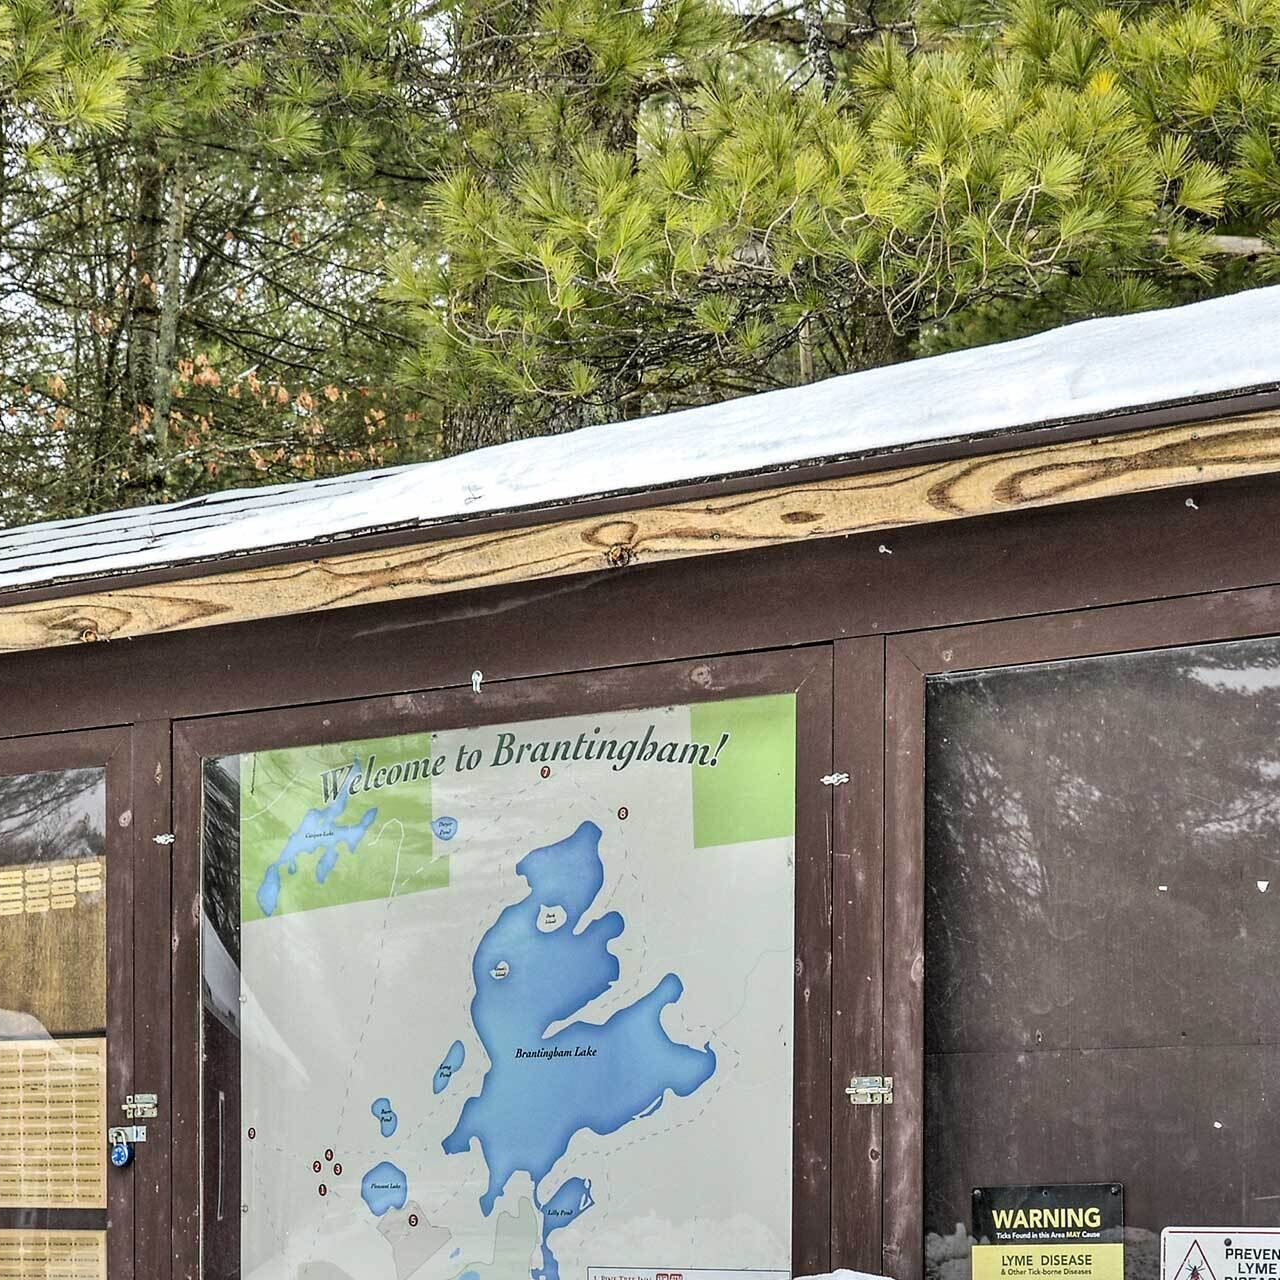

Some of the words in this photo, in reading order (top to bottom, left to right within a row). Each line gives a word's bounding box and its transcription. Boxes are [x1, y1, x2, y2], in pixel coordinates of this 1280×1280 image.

[320, 752, 446, 804] Welcome
[455, 744, 483, 773] to
[489, 724, 731, 772] Brantingham!
[515, 1048, 573, 1060] Brantingham
[574, 1046, 598, 1057] Lake
[991, 1207, 1101, 1229] WARNING
[996, 1231, 1012, 1240] Ticks
[1012, 1231, 1031, 1239] Found
[1032, 1231, 1038, 1239] in
[1038, 1231, 1050, 1239] this
[1050, 1230, 1066, 1239] Area
[1066, 1230, 1081, 1239] MAY
[1081, 1230, 1101, 1239] Cause
[1001, 1255, 1033, 1267] LYME
[1041, 1254, 1093, 1266] DISEASE
[1007, 1268, 1027, 1276] Other
[1028, 1268, 1062, 1276] Tick-borne
[1063, 1267, 1092, 1275] Diseases
[1237, 1262, 1278, 1275] LYME
